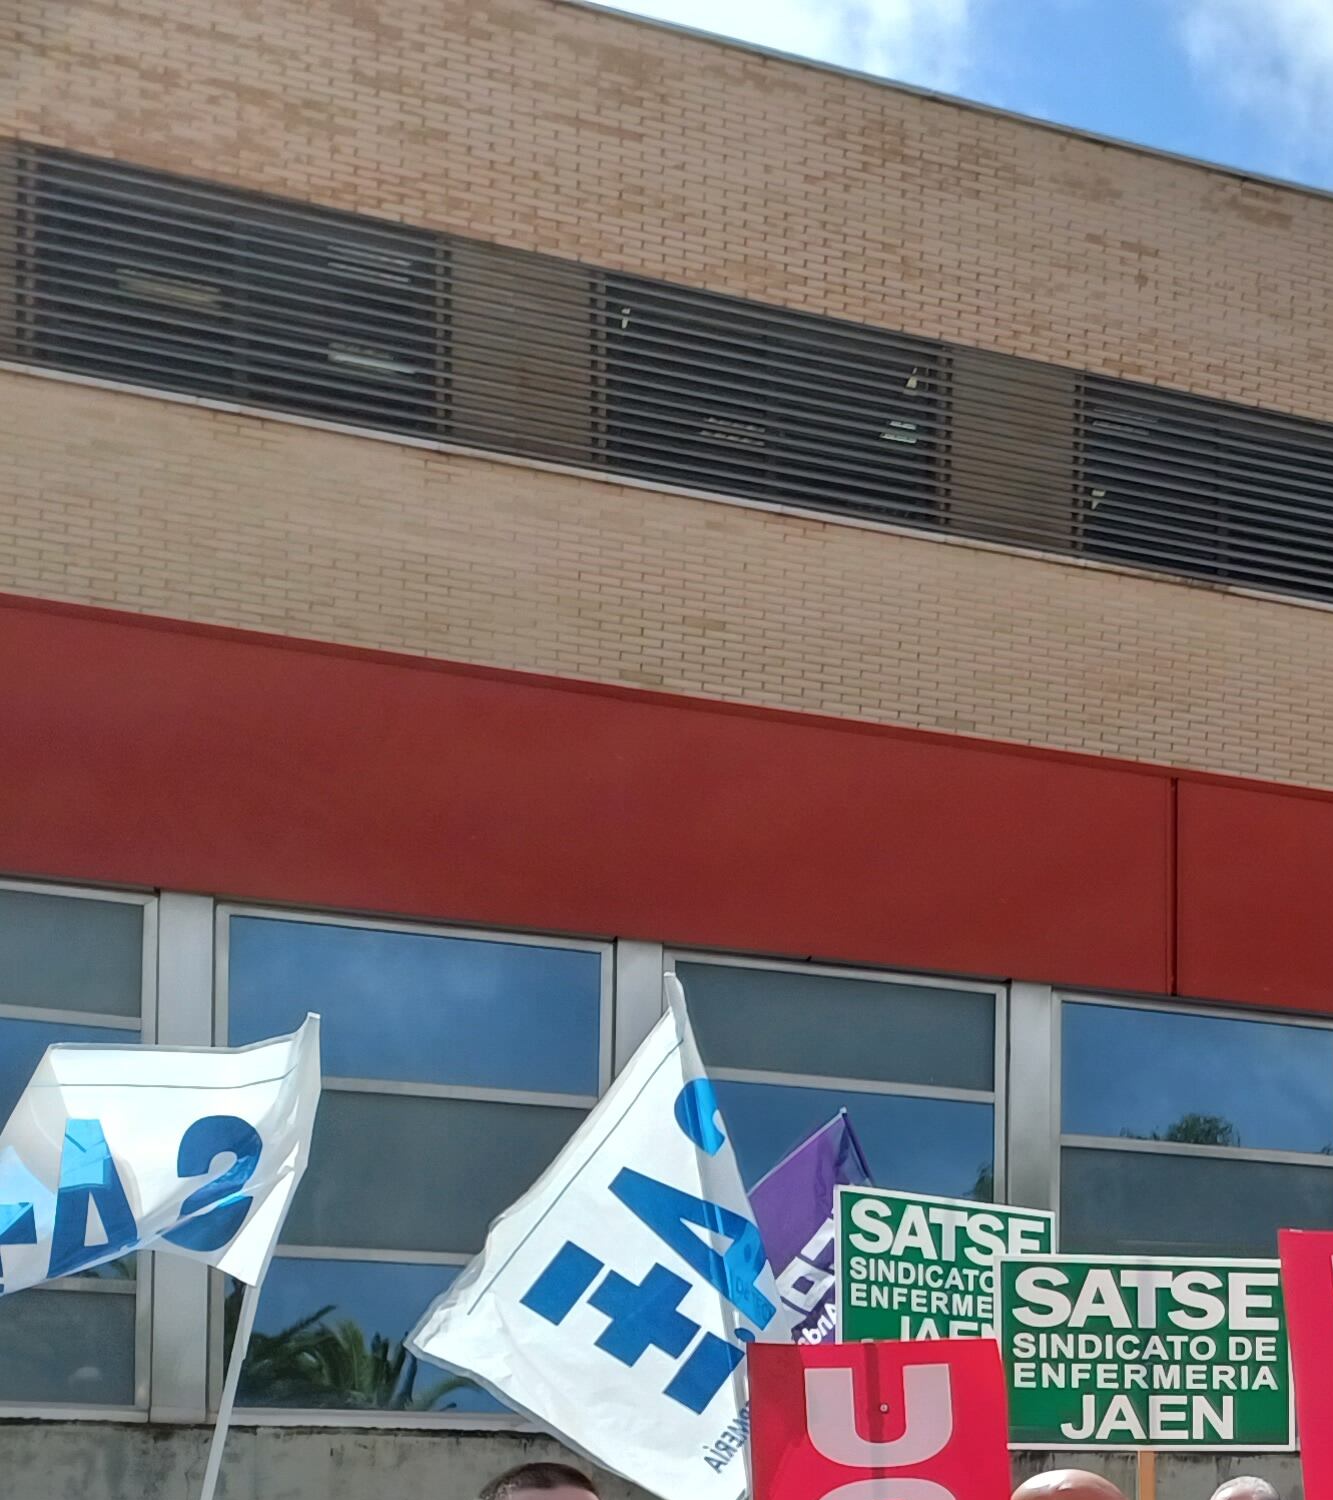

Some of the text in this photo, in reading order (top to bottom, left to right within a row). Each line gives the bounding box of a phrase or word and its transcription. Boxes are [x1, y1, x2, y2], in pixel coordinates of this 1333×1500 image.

[849, 1198, 1043, 1266] SATSE
[1012, 1266, 1280, 1331] SATSE
[1012, 1332, 1277, 1362] SINDICATO DE
[1013, 1362, 1279, 1391] ENFERMERIA
[1060, 1394, 1234, 1440] JAEN
